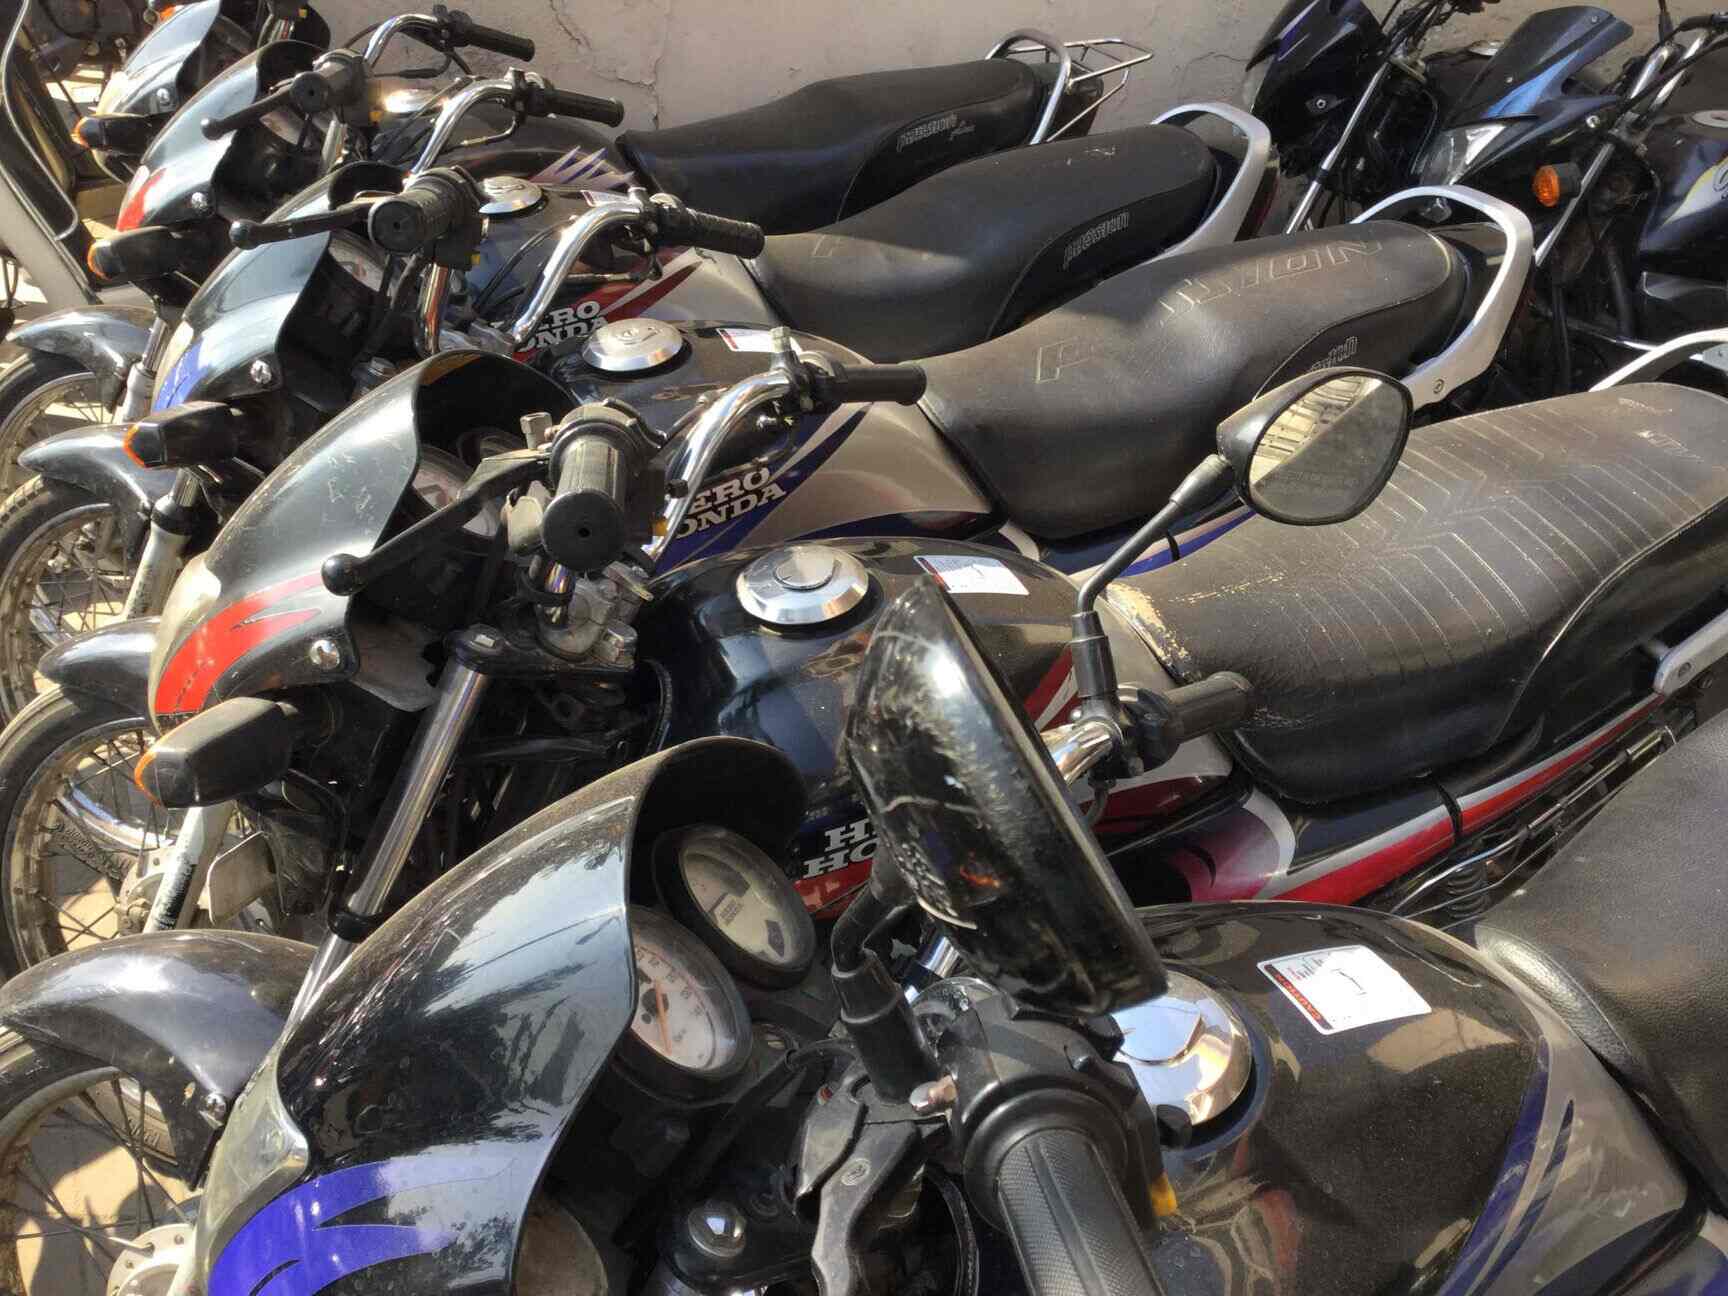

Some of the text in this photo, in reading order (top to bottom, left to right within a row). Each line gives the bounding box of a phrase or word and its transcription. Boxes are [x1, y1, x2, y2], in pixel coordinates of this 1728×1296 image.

[537, 300, 600, 330] RO
[676, 482, 787, 539] ONDA
[688, 467, 771, 515] ERO
